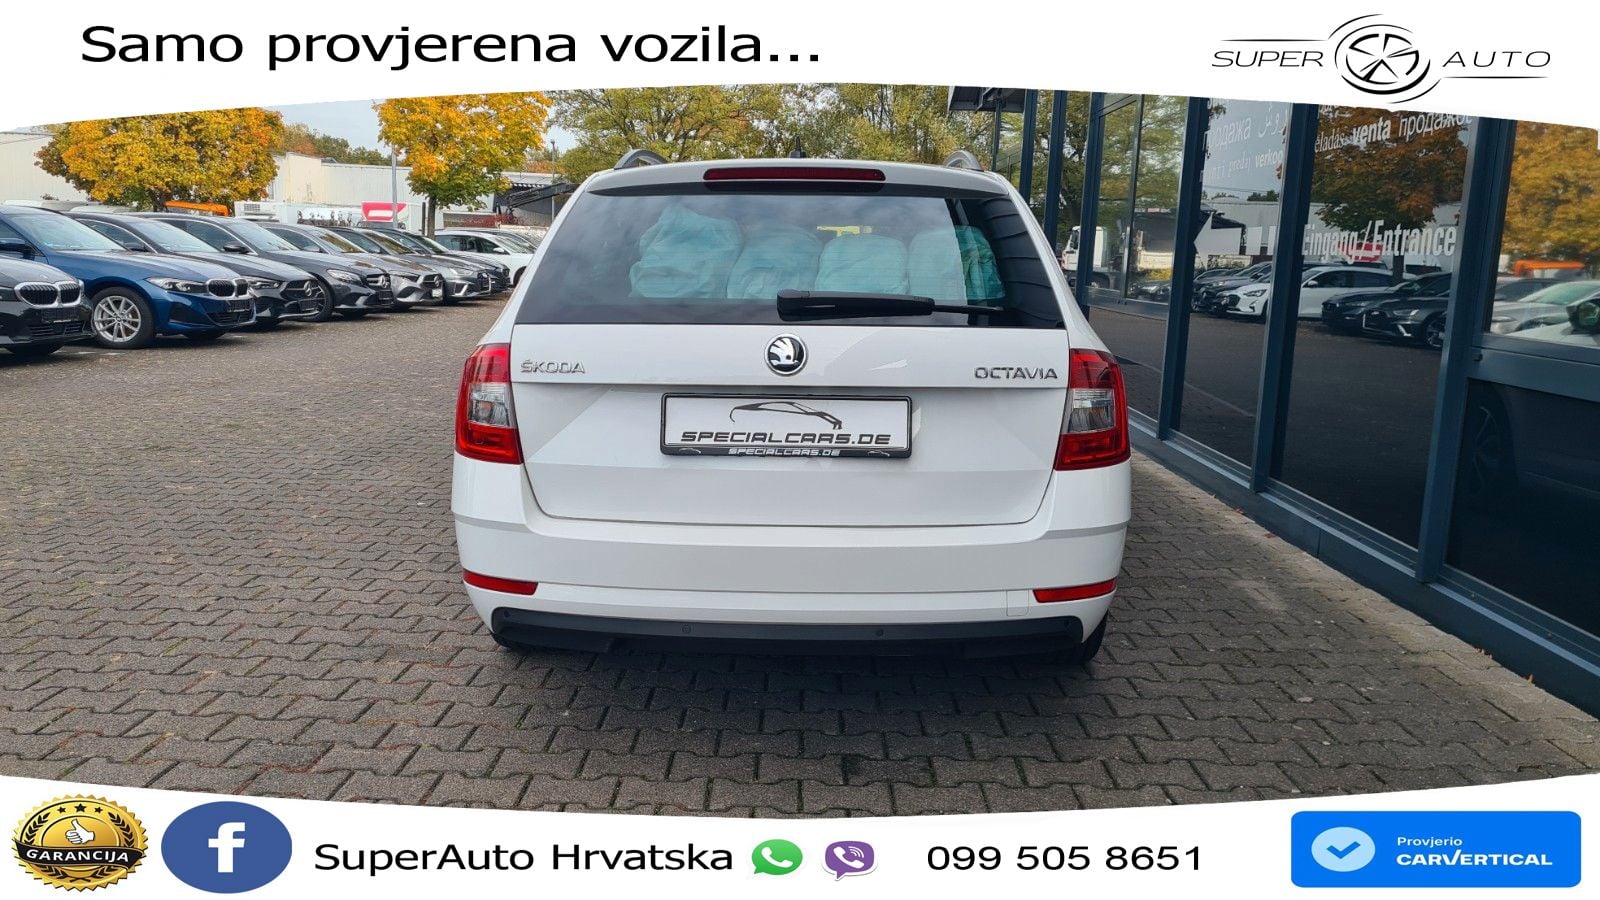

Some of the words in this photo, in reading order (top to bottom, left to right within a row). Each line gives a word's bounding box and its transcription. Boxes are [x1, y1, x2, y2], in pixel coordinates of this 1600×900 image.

[1353, 117, 1392, 144] venta
[1255, 148, 1284, 168] verkoo
[520, 359, 586, 374] ŠKODA
[974, 366, 1059, 380] OCTAVIA
[680, 431, 892, 446] SPECIALCARS.DE
[727, 447, 841, 457] SPECIALCARS.DE
